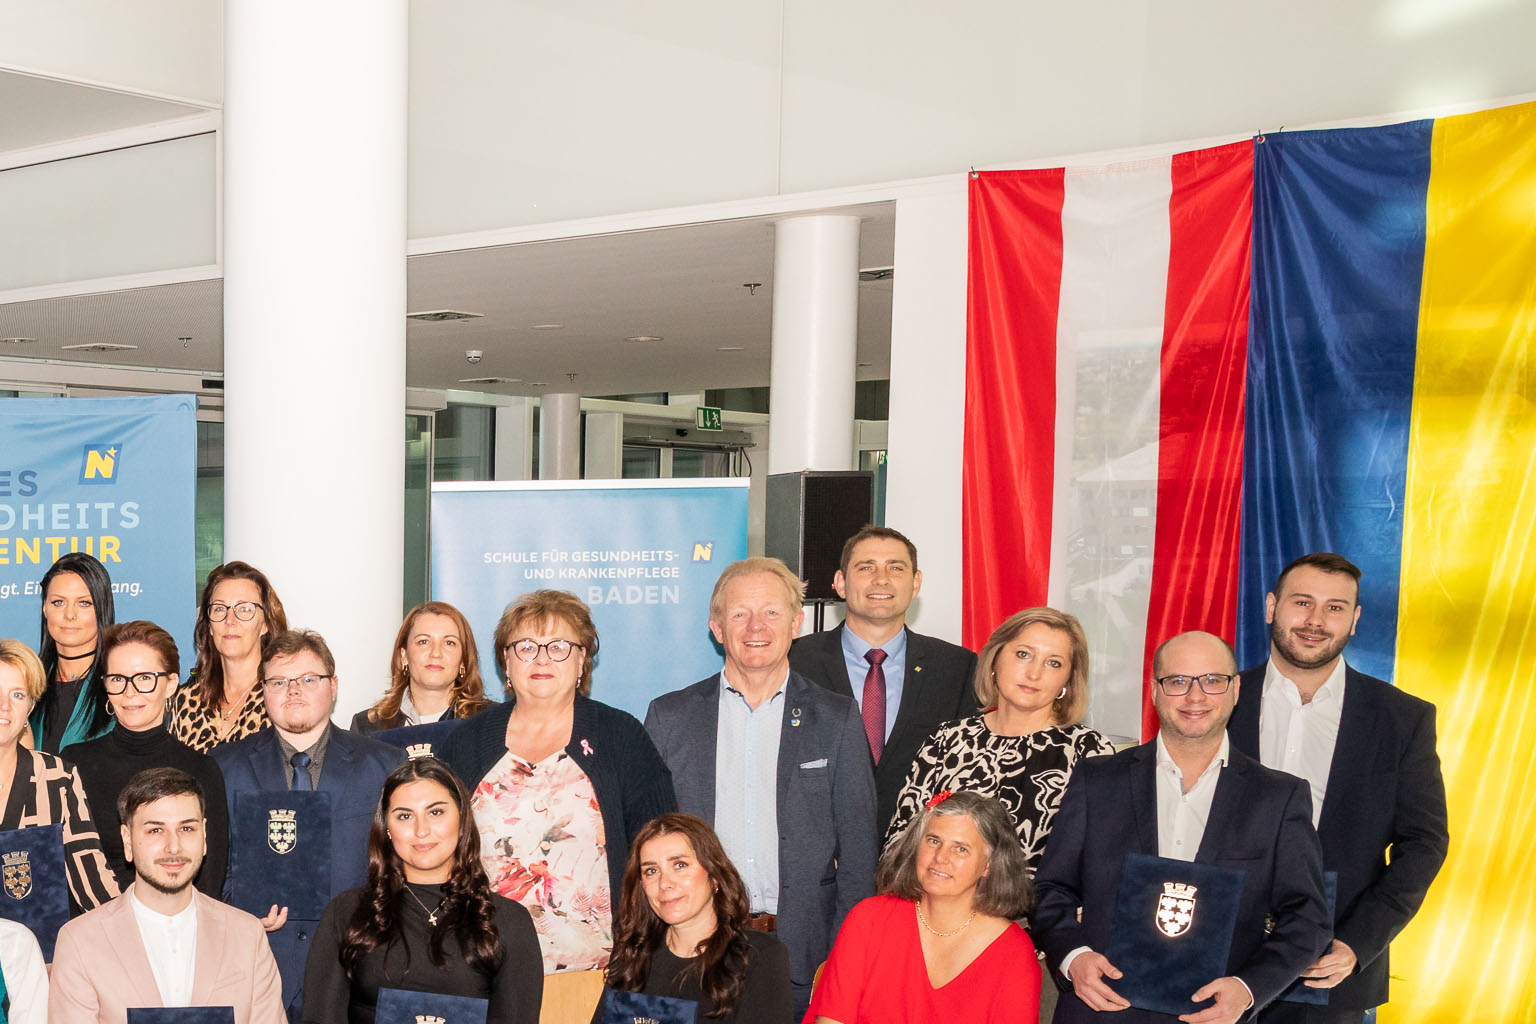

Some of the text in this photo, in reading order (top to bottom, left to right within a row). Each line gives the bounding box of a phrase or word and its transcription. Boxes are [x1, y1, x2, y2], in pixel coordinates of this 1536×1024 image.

[483, 549, 680, 564] SCHULE FÜR GESUNDHEITS-
[524, 567, 680, 580] UND KRANKENPFLEGE
[111, 582, 143, 597] ang.
[587, 585, 680, 605] BADEN
